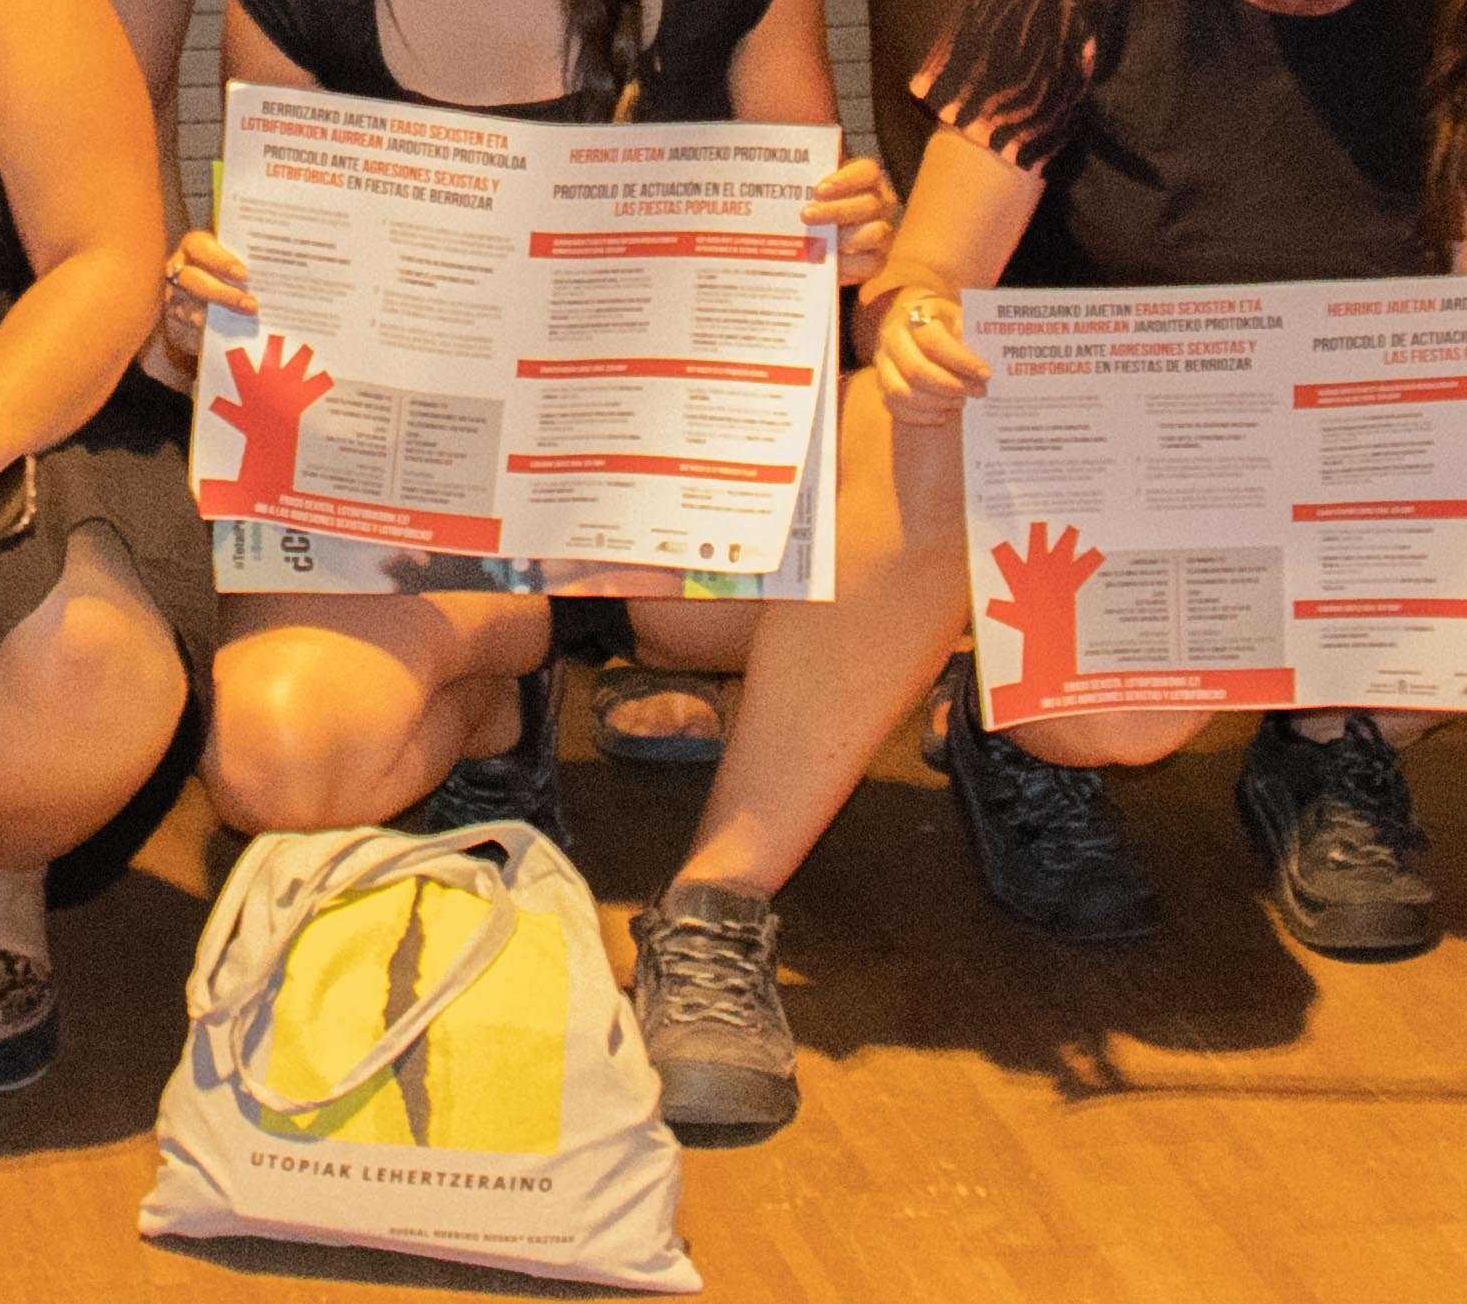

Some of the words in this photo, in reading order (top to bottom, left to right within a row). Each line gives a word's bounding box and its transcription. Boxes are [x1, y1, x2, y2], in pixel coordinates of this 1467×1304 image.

[262, 101, 340, 125] BERRIOZARKO
[343, 112, 387, 131] JAIETAN
[390, 119, 427, 137] ERASO
[429, 124, 484, 146] SEXISTEN
[487, 132, 509, 150] ETA
[241, 116, 328, 143] LGTBIFOBIKOEN
[331, 129, 383, 150] AURREAN
[385, 136, 449, 160] JARDUTEKO
[453, 145, 527, 171] PROTOKOLOA
[569, 148, 619, 163] HERRIKO
[621, 147, 665, 163] JAIETAN
[668, 146, 731, 162] JARDUTEKO
[734, 146, 810, 163] PROTOKOLOA
[264, 144, 328, 167] PROTOCOLO
[331, 154, 360, 172] ANTE
[363, 159, 431, 182] AGRESIONES
[434, 169, 489, 191] SEXISTAS
[492, 178, 500, 192] Y
[347, 175, 362, 191] EN
[365, 177, 410, 198] FIESTAS
[413, 184, 426, 200] DE
[429, 187, 493, 211] BERRIOZAR
[553, 184, 618, 199] PROTOCOLO
[622, 183, 637, 198] DE
[640, 181, 701, 198] ACTUACIÓN
[705, 183, 721, 196] EN
[724, 183, 736, 196] EL
[740, 183, 802, 200] CONTEXTO
[806, 185, 815, 201] D
[615, 202, 635, 216] LAS
[639, 201, 682, 216] FIESTAS
[685, 201, 751, 216] POPULARES
[998, 303, 1081, 319] BERRIOZARKO
[1085, 302, 1132, 317] JAIETAN
[1135, 301, 1175, 315] ERASO
[1178, 300, 1236, 314] SEXISTEN
[1239, 299, 1262, 313] ETA
[1327, 301, 1382, 317] HERRIKO
[1385, 299, 1436, 314] JAIETAN
[1074, 319, 1129, 334] AURREAN
[1133, 318, 1202, 333] JARDUTEKO
[1205, 316, 1283, 331] PROTOKOLOA
[1003, 344, 1073, 359] PROTOCOLO
[1076, 344, 1106, 358] ANTE
[1109, 342, 1184, 357] AGRESIONES
[1187, 341, 1247, 355] SEXISTAS
[1250, 340, 1257, 353] Y
[1313, 335, 1386, 352] PROTOCOLO
[1391, 334, 1407, 348] DE
[1383, 349, 1408, 365] LAS
[1411, 347, 1462, 364] FIESTAS
[1095, 361, 1111, 374] EN
[1115, 360, 1163, 374] FIESTAS
[1166, 359, 1180, 373] DE
[1184, 358, 1252, 372] BERRIOZAR
[250, 1151, 352, 1179] UTOPIAK
[362, 1166, 554, 1192] LEHERTZERAINO
